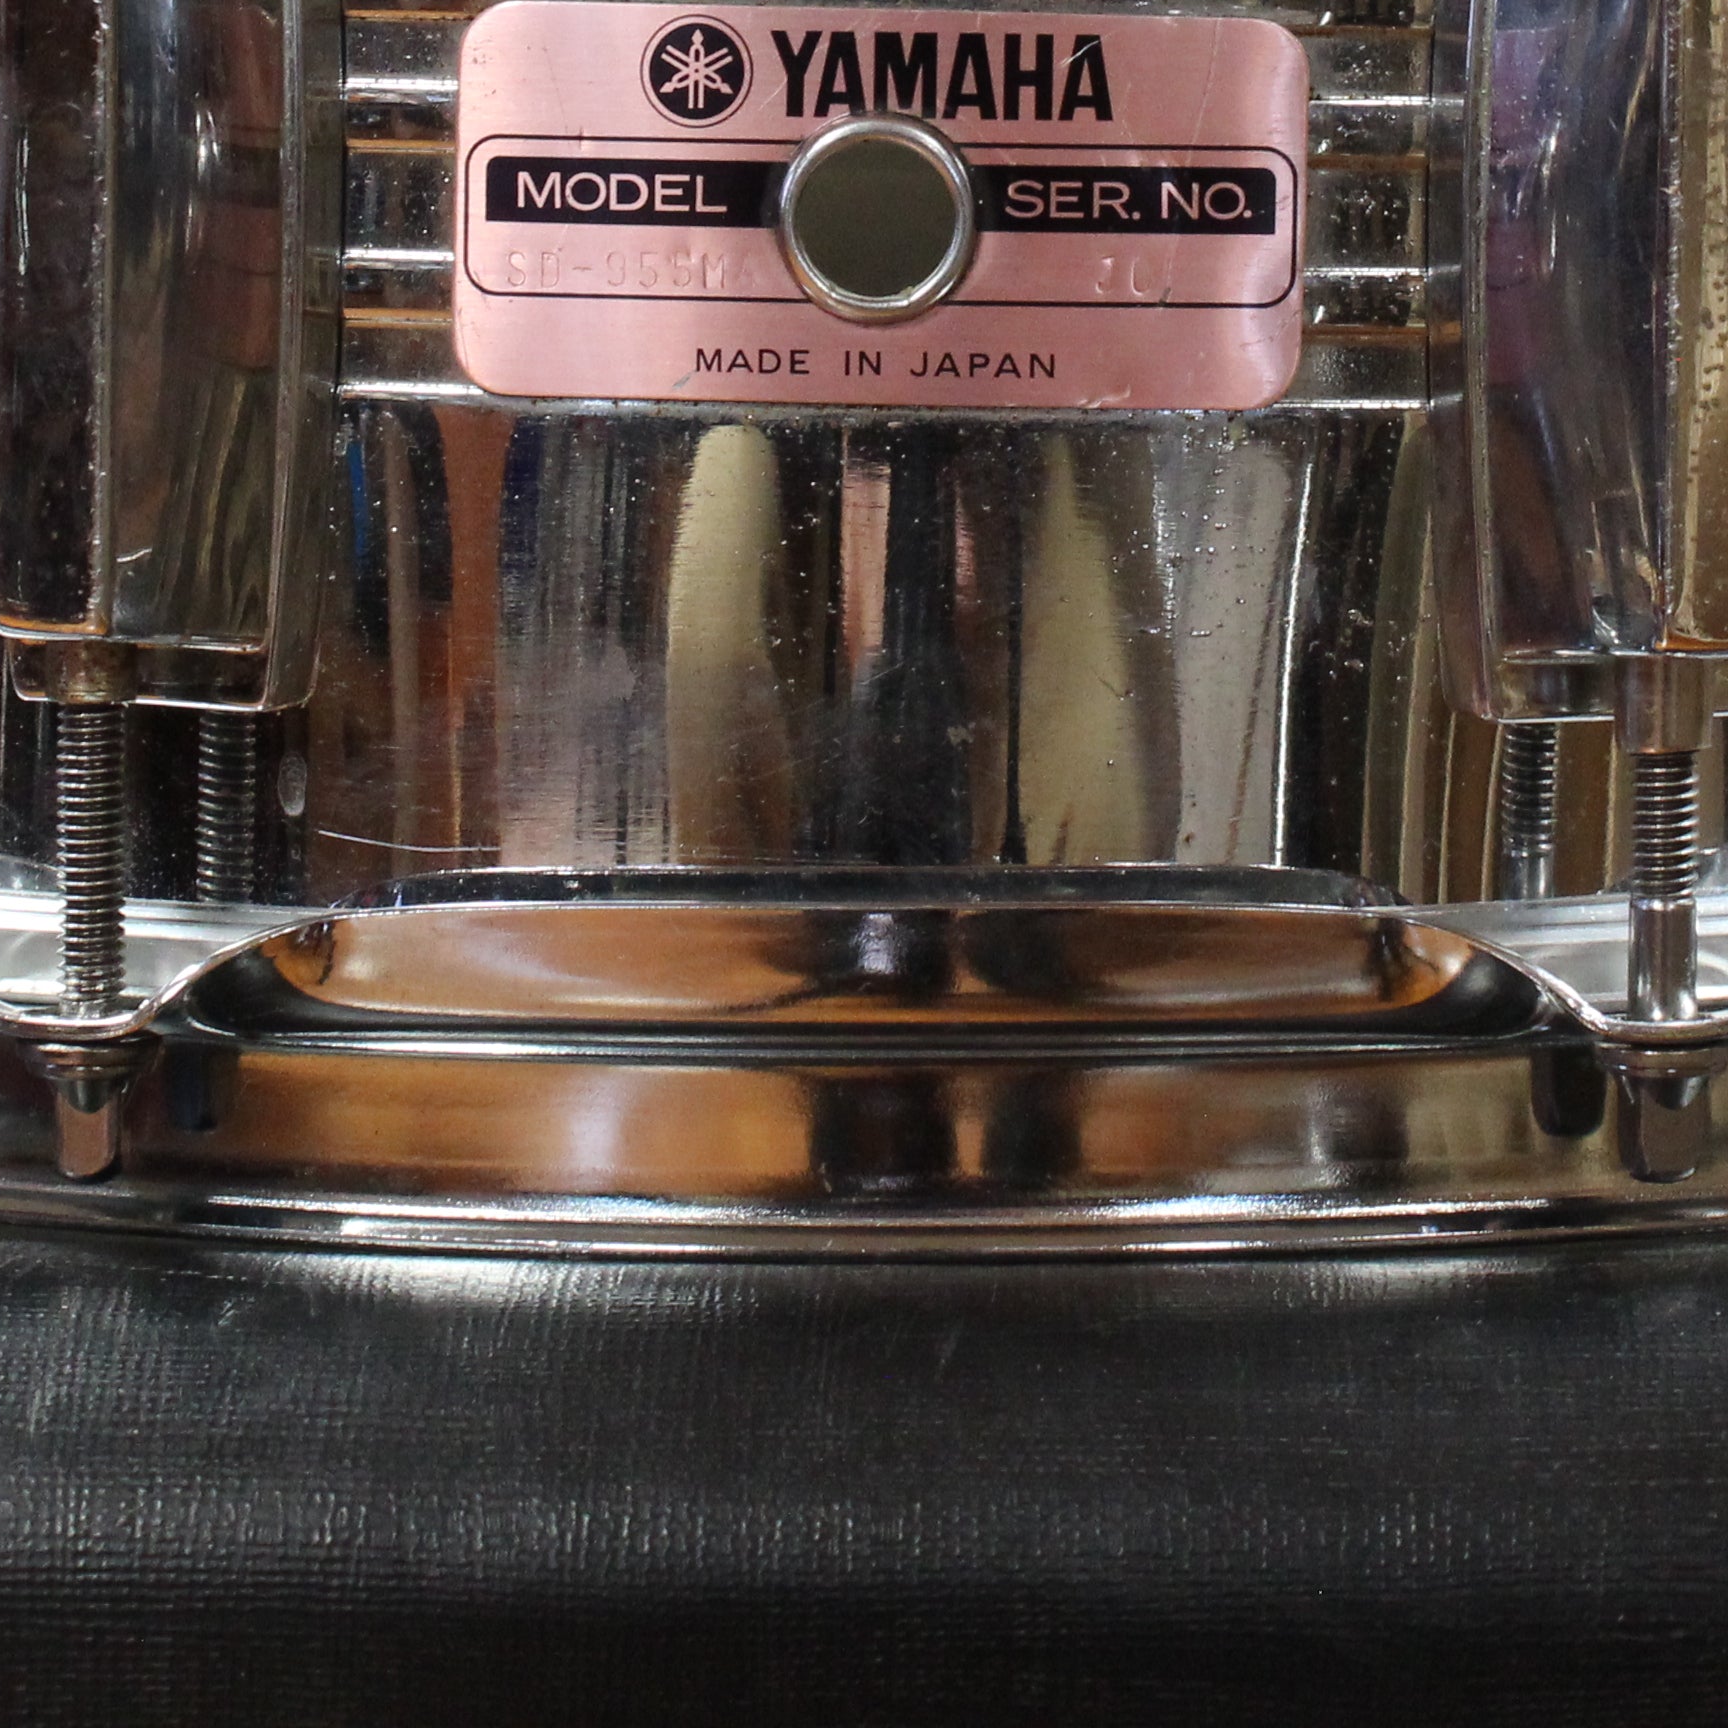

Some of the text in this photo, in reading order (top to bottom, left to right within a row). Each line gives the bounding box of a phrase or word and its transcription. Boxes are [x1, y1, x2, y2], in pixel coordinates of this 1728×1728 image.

[770, 29, 1114, 123] YAMAHA
[517, 171, 728, 213] MODEL
[1004, 179, 1253, 221] SER. NO.
[696, 348, 1057, 380] MADE IN JAPAN
